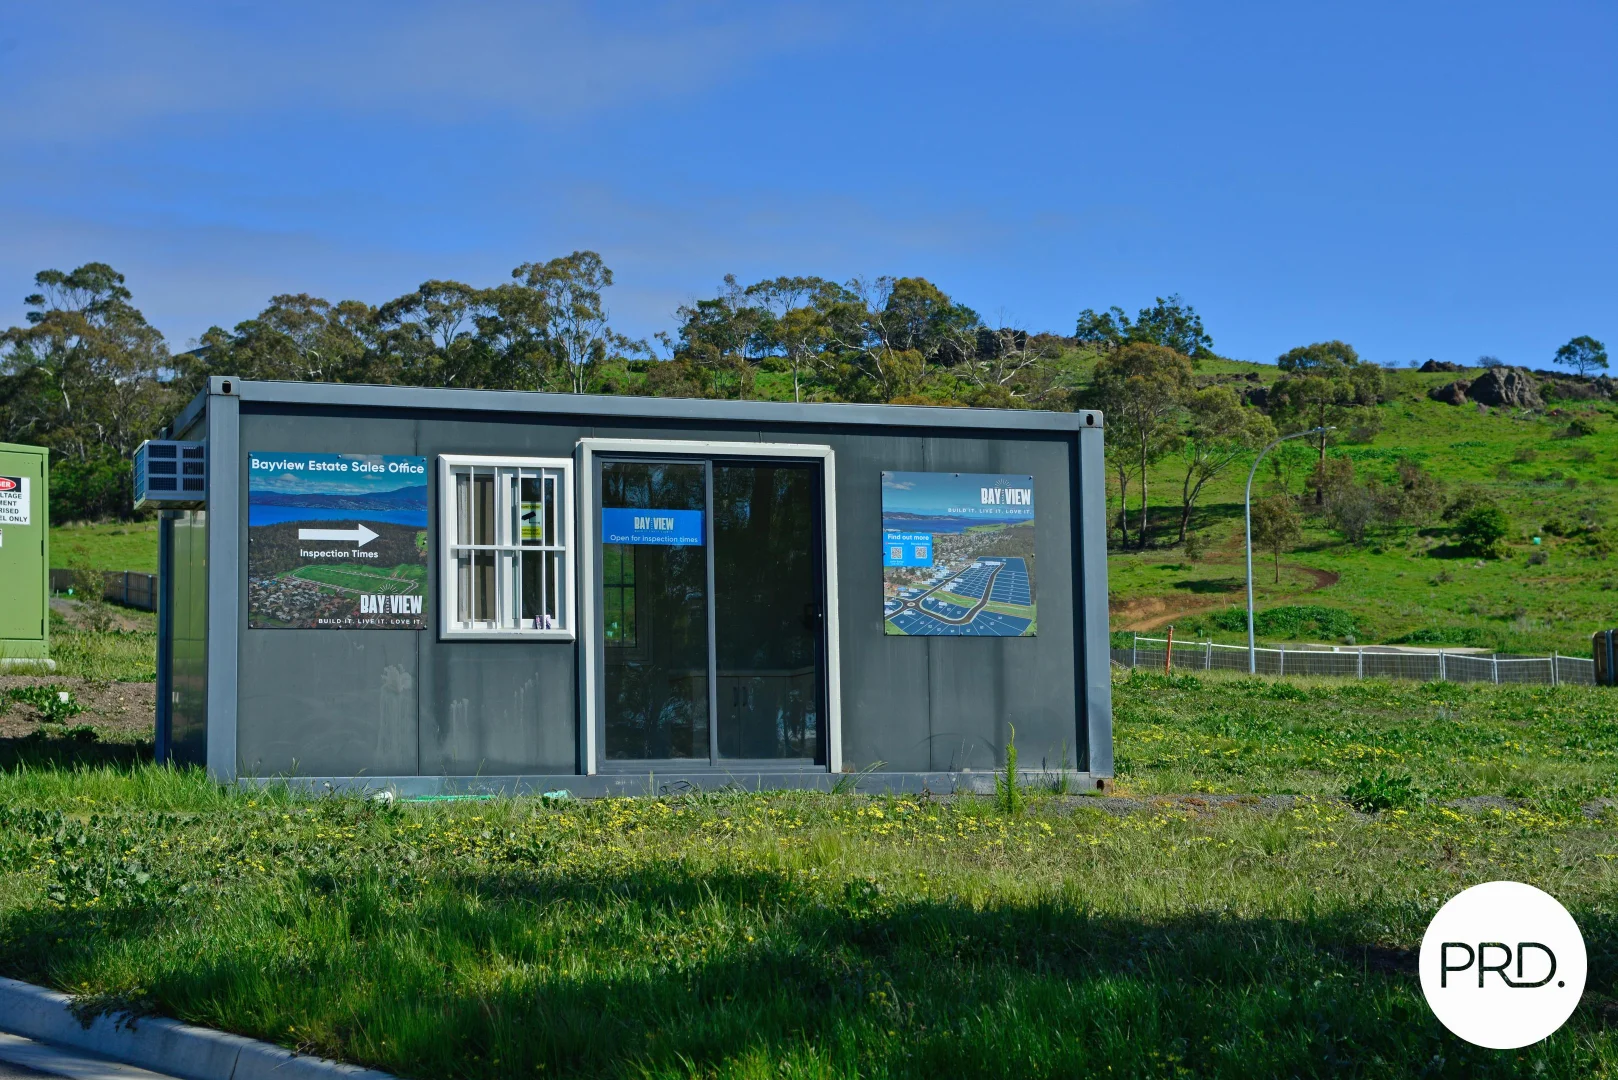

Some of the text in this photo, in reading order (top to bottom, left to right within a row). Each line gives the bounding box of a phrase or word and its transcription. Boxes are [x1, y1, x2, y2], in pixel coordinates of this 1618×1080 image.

[251, 458, 425, 474] Bayview Estate Sales Office
[980, 487, 1001, 505] BAY
[1004, 488, 1031, 505] VIEW
[634, 516, 651, 530] BAY
[653, 517, 674, 531] VIEW
[610, 534, 629, 542] Open
[300, 548, 379, 559] Inspection Times
[360, 594, 423, 614] BAY VIEW
